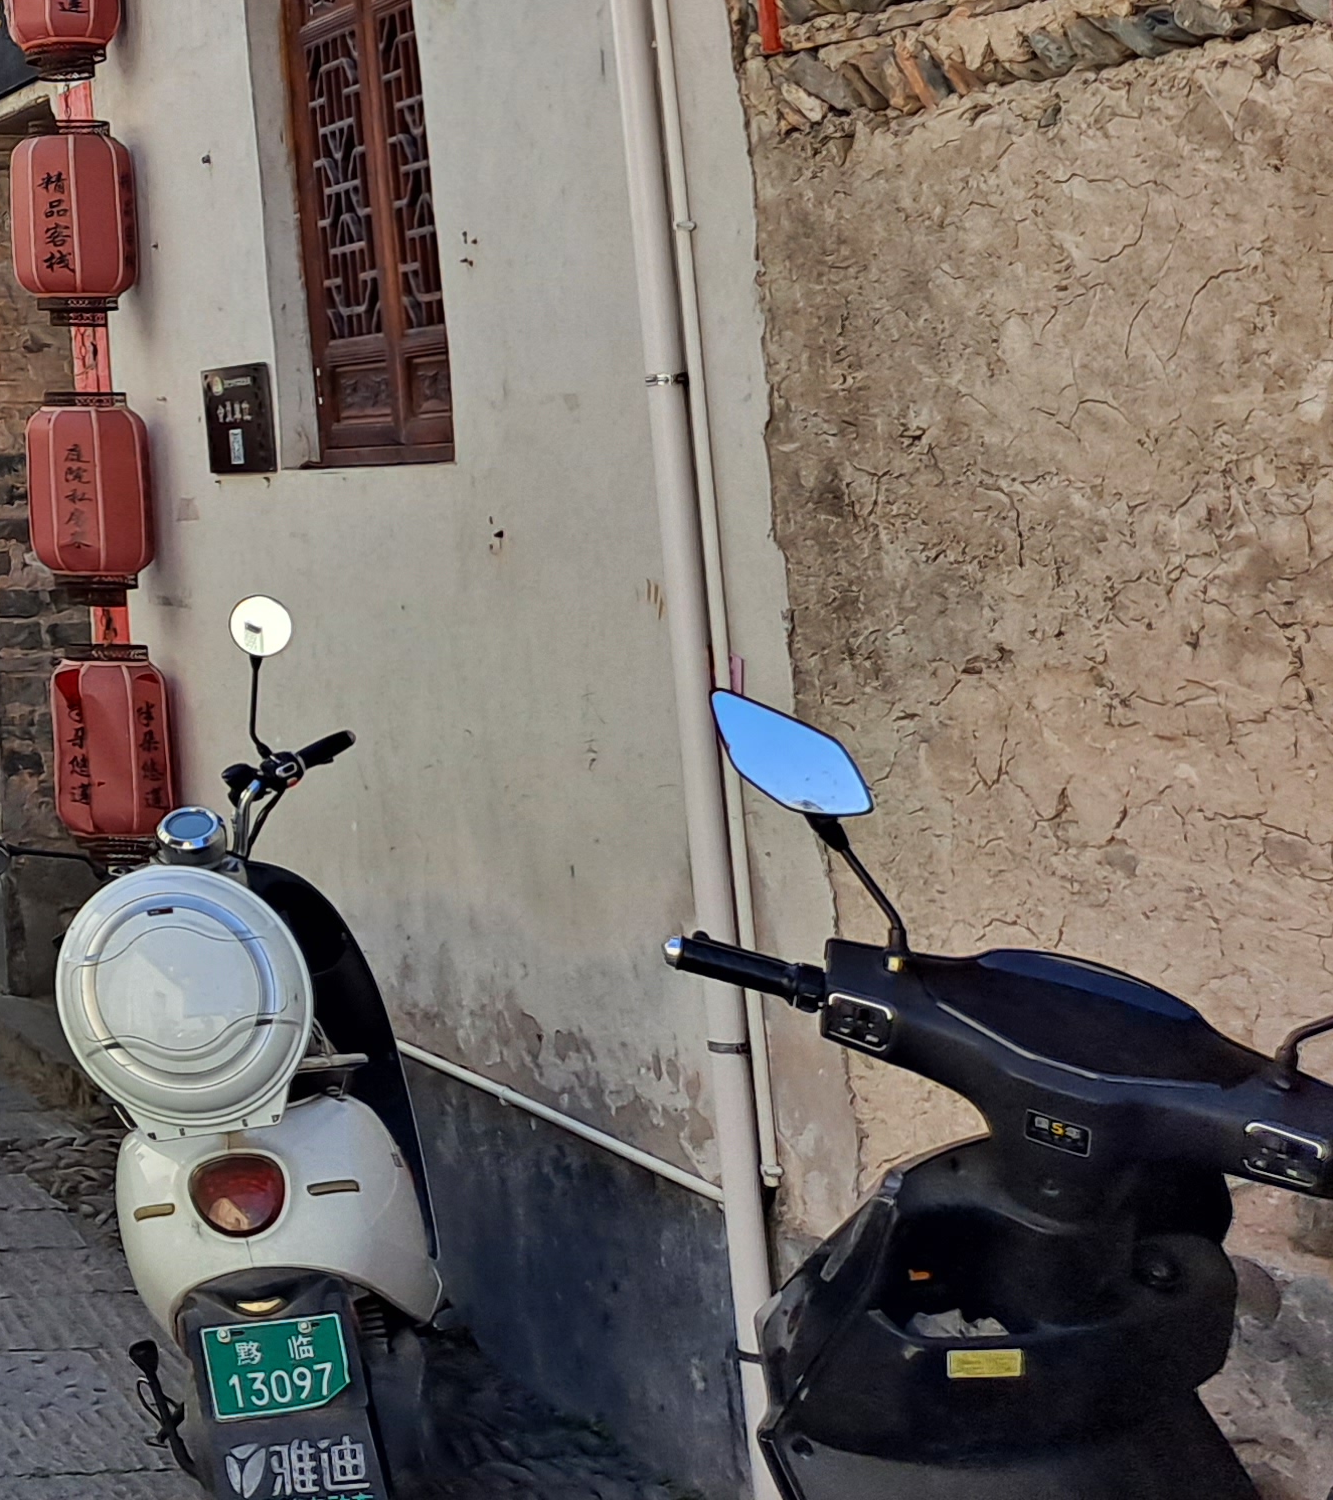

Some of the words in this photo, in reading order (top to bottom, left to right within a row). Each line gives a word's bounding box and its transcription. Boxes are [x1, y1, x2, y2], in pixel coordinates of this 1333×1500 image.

[37, 171, 76, 274] 精品客栈
[287, 1334, 315, 1362] 临
[228, 1362, 335, 1410] 13097
[268, 1435, 371, 1497] 雅迪
